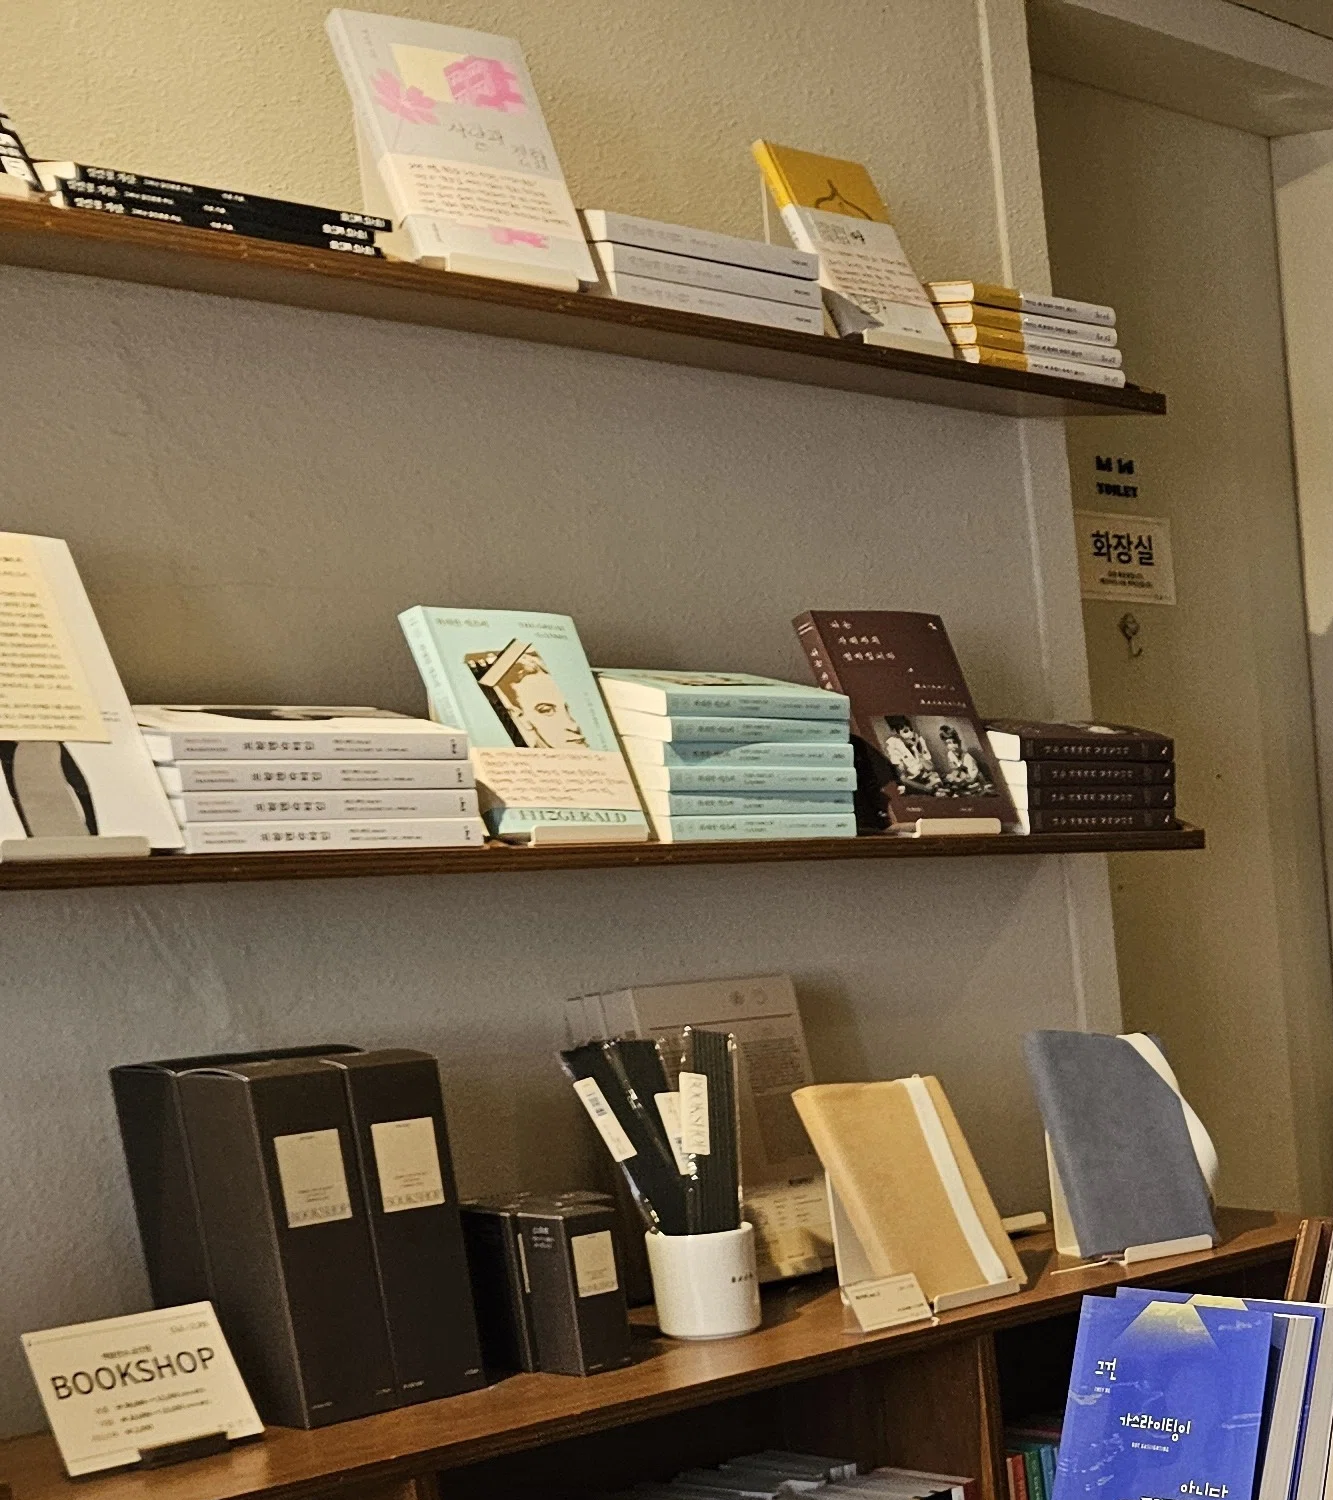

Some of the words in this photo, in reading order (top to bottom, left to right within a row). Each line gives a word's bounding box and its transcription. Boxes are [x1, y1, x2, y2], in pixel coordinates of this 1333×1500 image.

[1091, 530, 1154, 566] 화장실
[518, 810, 626, 824] FITZGERALD
[51, 1347, 215, 1400] BOOKSHOP
[1095, 1358, 1117, 1380] 그건
[1120, 1413, 1191, 1442] 가스라이팅이
[1180, 1481, 1229, 1499] 아니다
